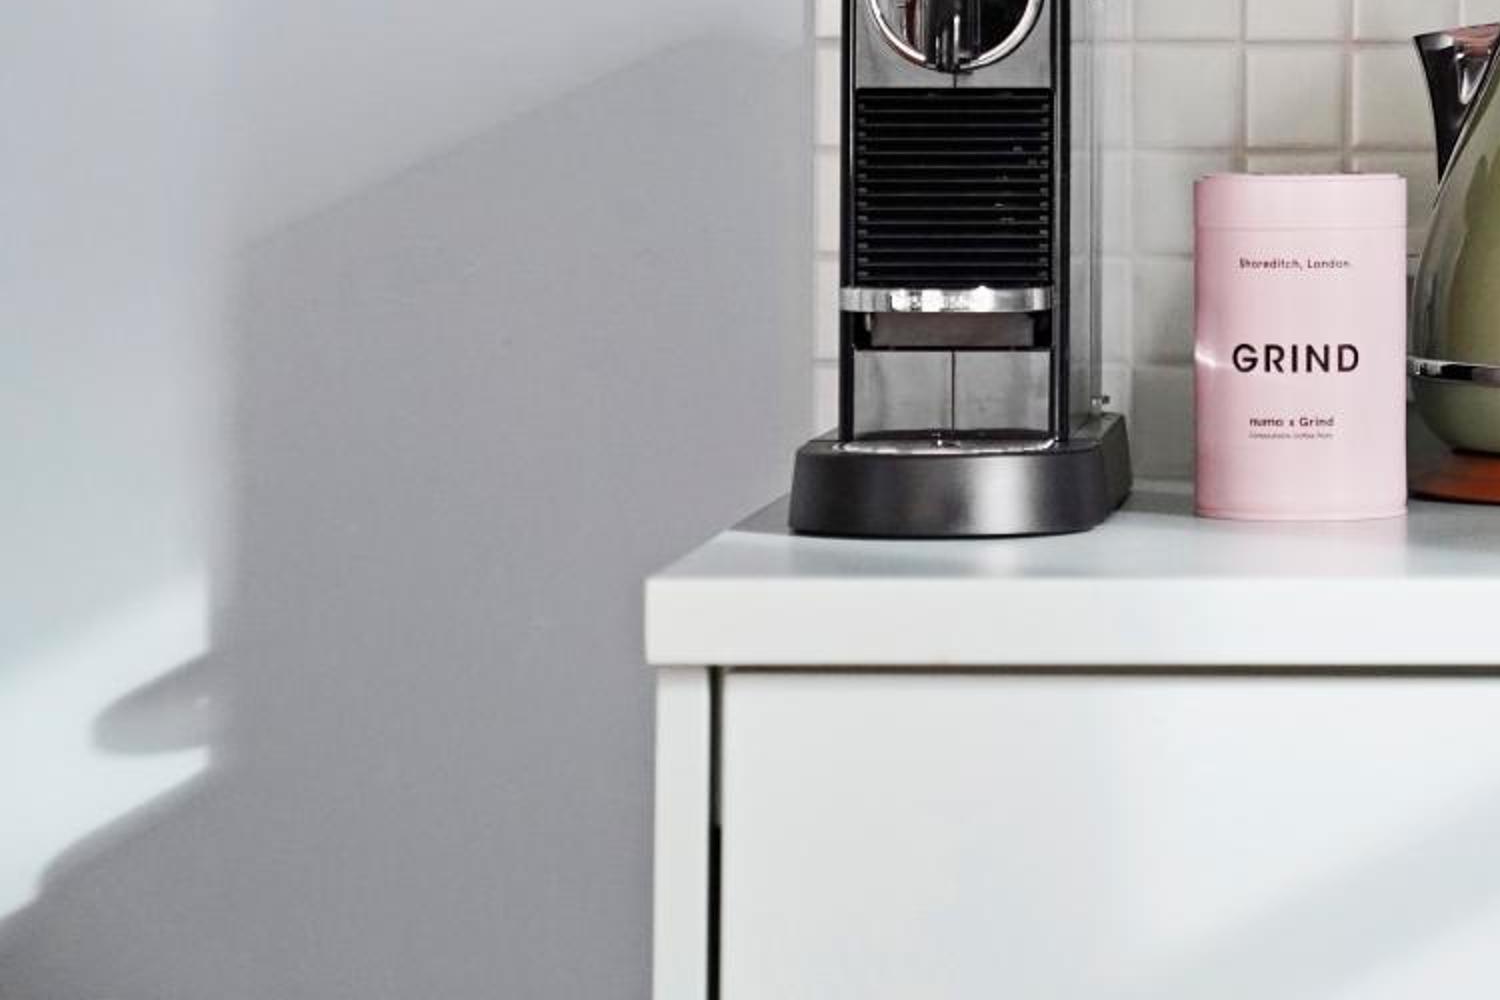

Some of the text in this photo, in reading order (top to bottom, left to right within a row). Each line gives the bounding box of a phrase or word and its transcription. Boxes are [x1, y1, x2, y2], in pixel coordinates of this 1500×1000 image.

[1239, 257, 1350, 271] Shoreditch, London
[1232, 343, 1359, 373] GRIND
[1299, 417, 1334, 427] Grind
